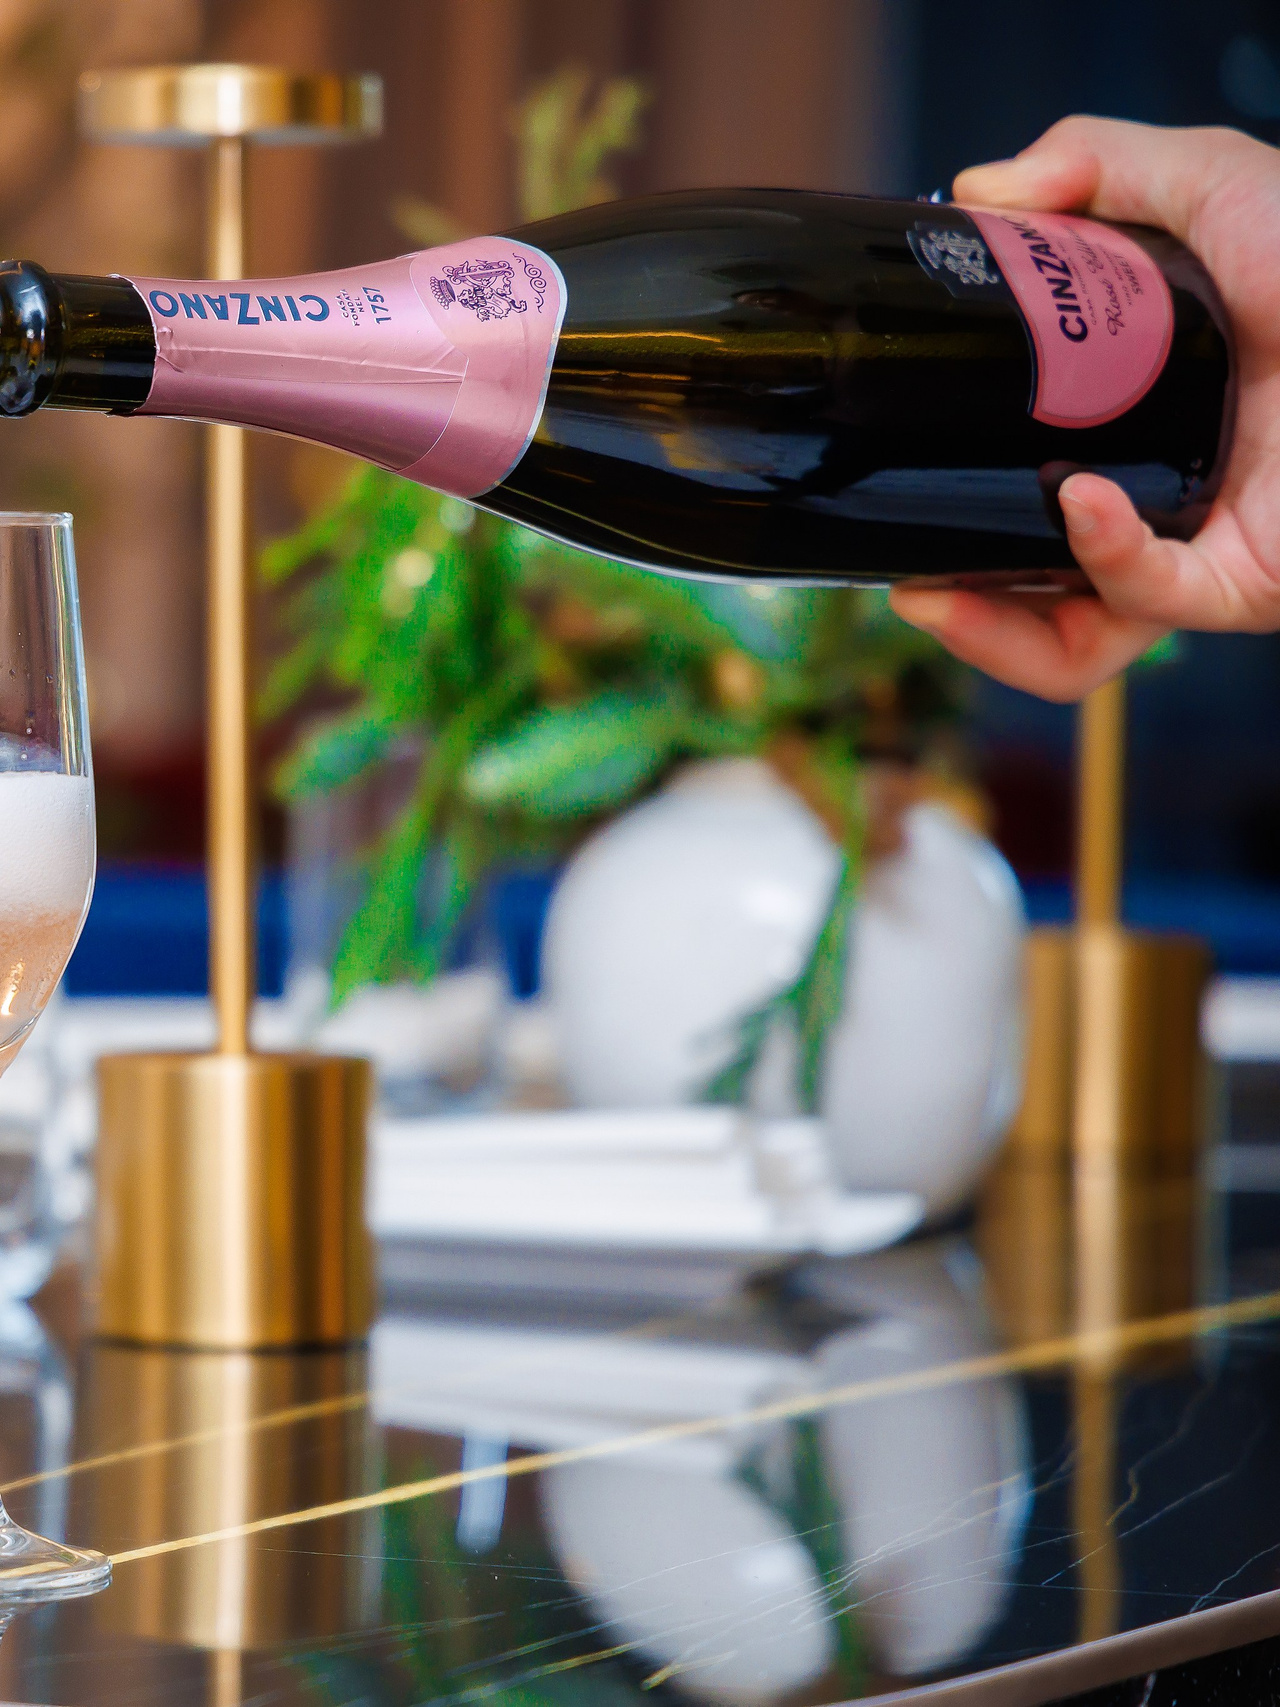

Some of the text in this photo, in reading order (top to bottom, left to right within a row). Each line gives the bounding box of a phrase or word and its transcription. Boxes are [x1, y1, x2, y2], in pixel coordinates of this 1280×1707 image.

[149, 290, 330, 325] CINZANO
[335, 295, 349, 318] CASA
[354, 297, 365, 313] NEL
[361, 286, 392, 325] 1757
